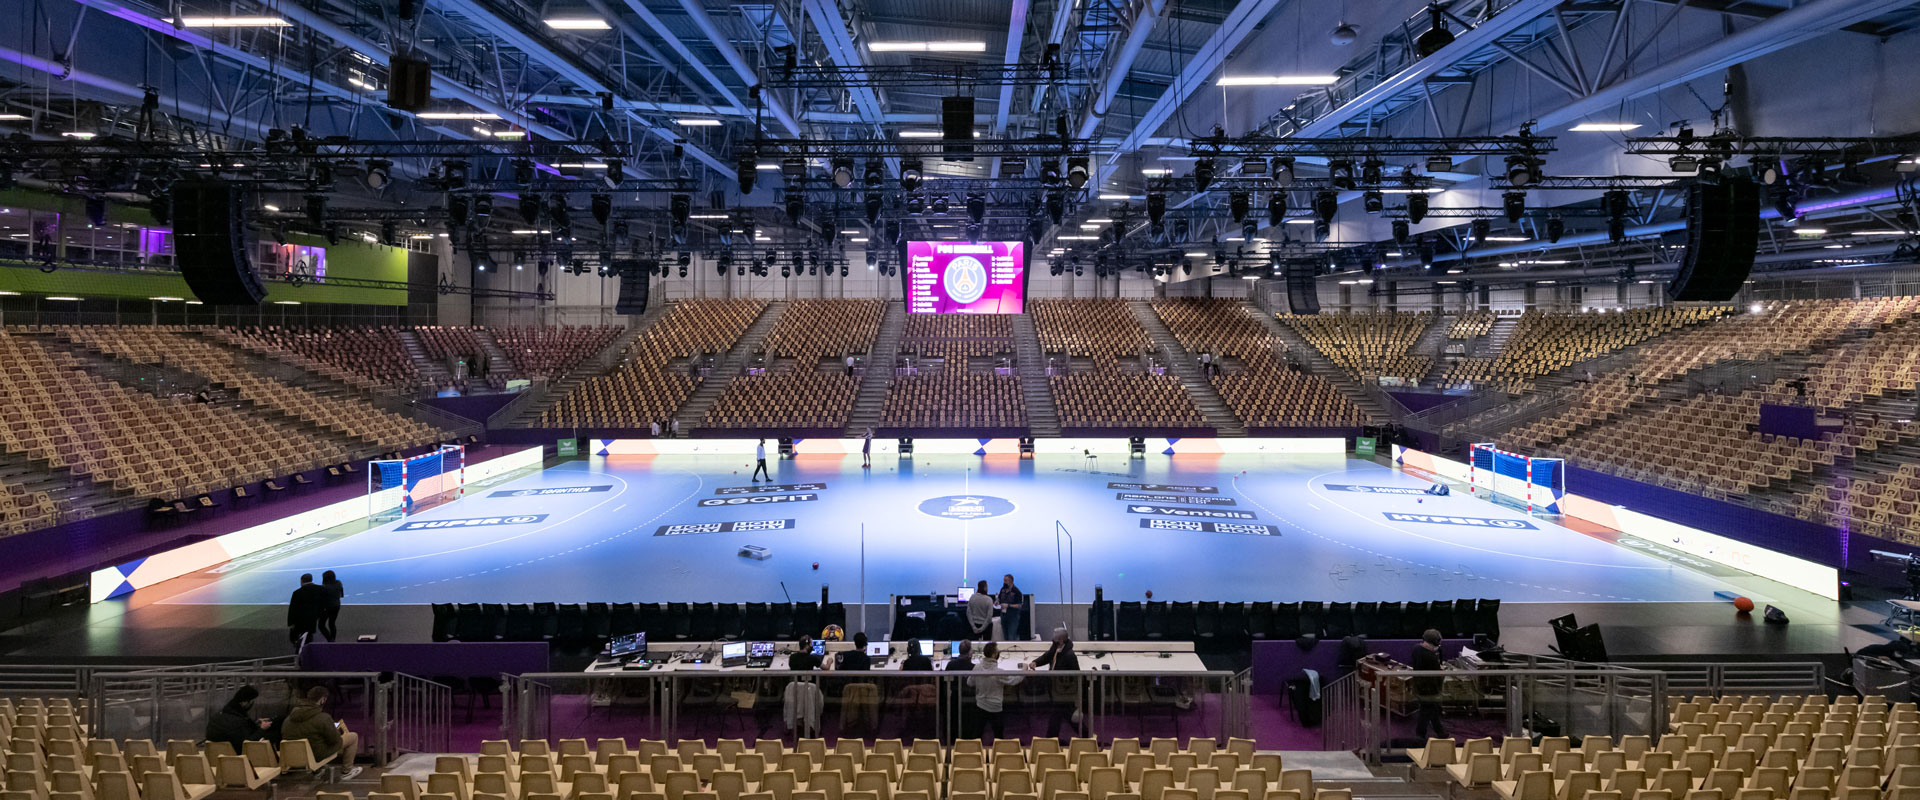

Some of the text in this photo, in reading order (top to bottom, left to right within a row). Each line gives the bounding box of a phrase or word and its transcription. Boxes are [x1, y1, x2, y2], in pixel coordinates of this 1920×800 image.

[951, 259, 979, 271] PARIS
[703, 494, 813, 506] GEOFIT
[406, 518, 502, 529] SUPER
[1391, 513, 1490, 526] HYPER
